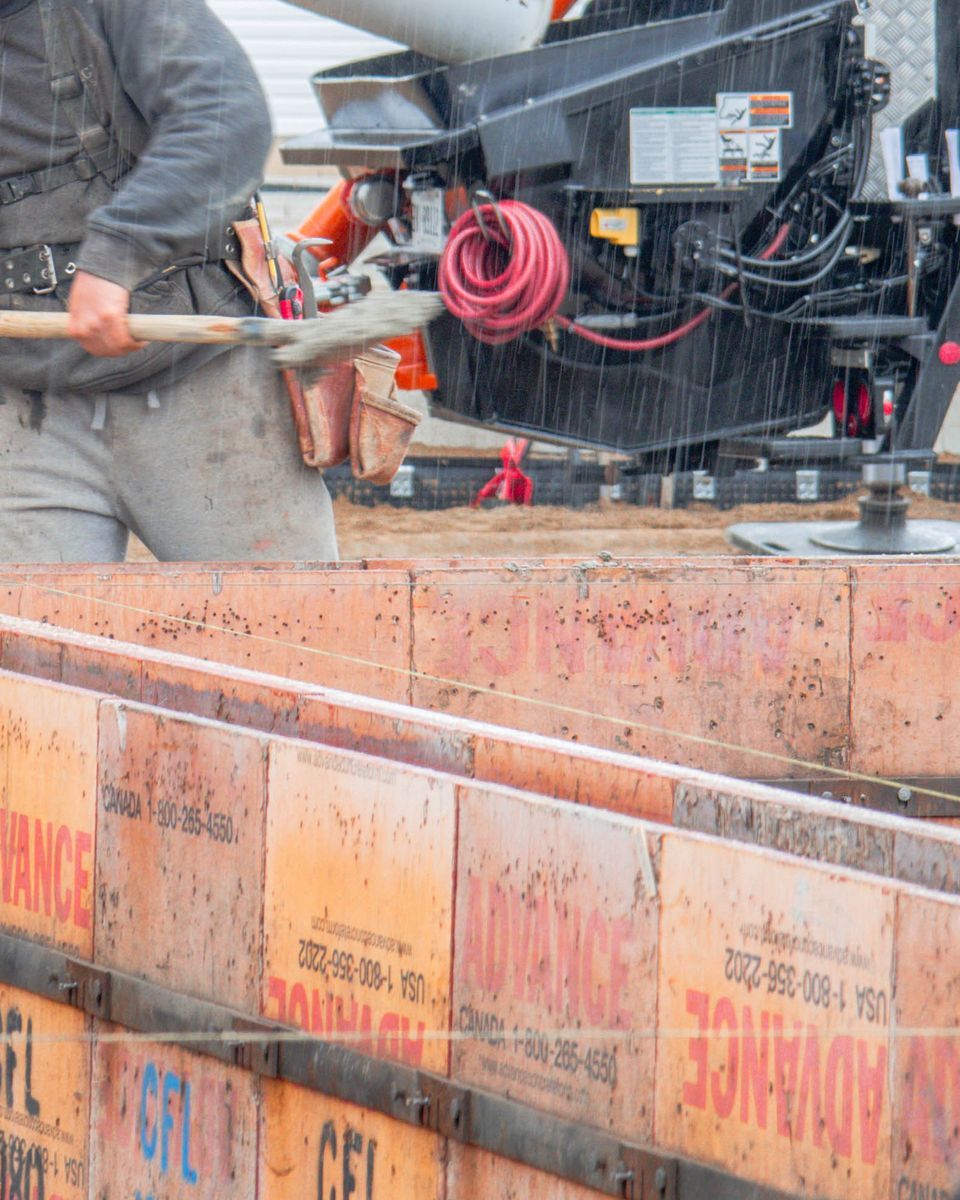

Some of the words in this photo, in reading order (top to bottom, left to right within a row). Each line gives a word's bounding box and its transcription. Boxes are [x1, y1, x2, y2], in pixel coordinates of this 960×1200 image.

[298, 939, 394, 995] 1-800-356-2202
[400, 968, 426, 1005] USA
[724, 947, 846, 1013] 1-800-356-2202
[855, 983, 888, 1026] USA
[141, 1061, 198, 1185] CFL
[683, 988, 889, 1166] ADVANCE
